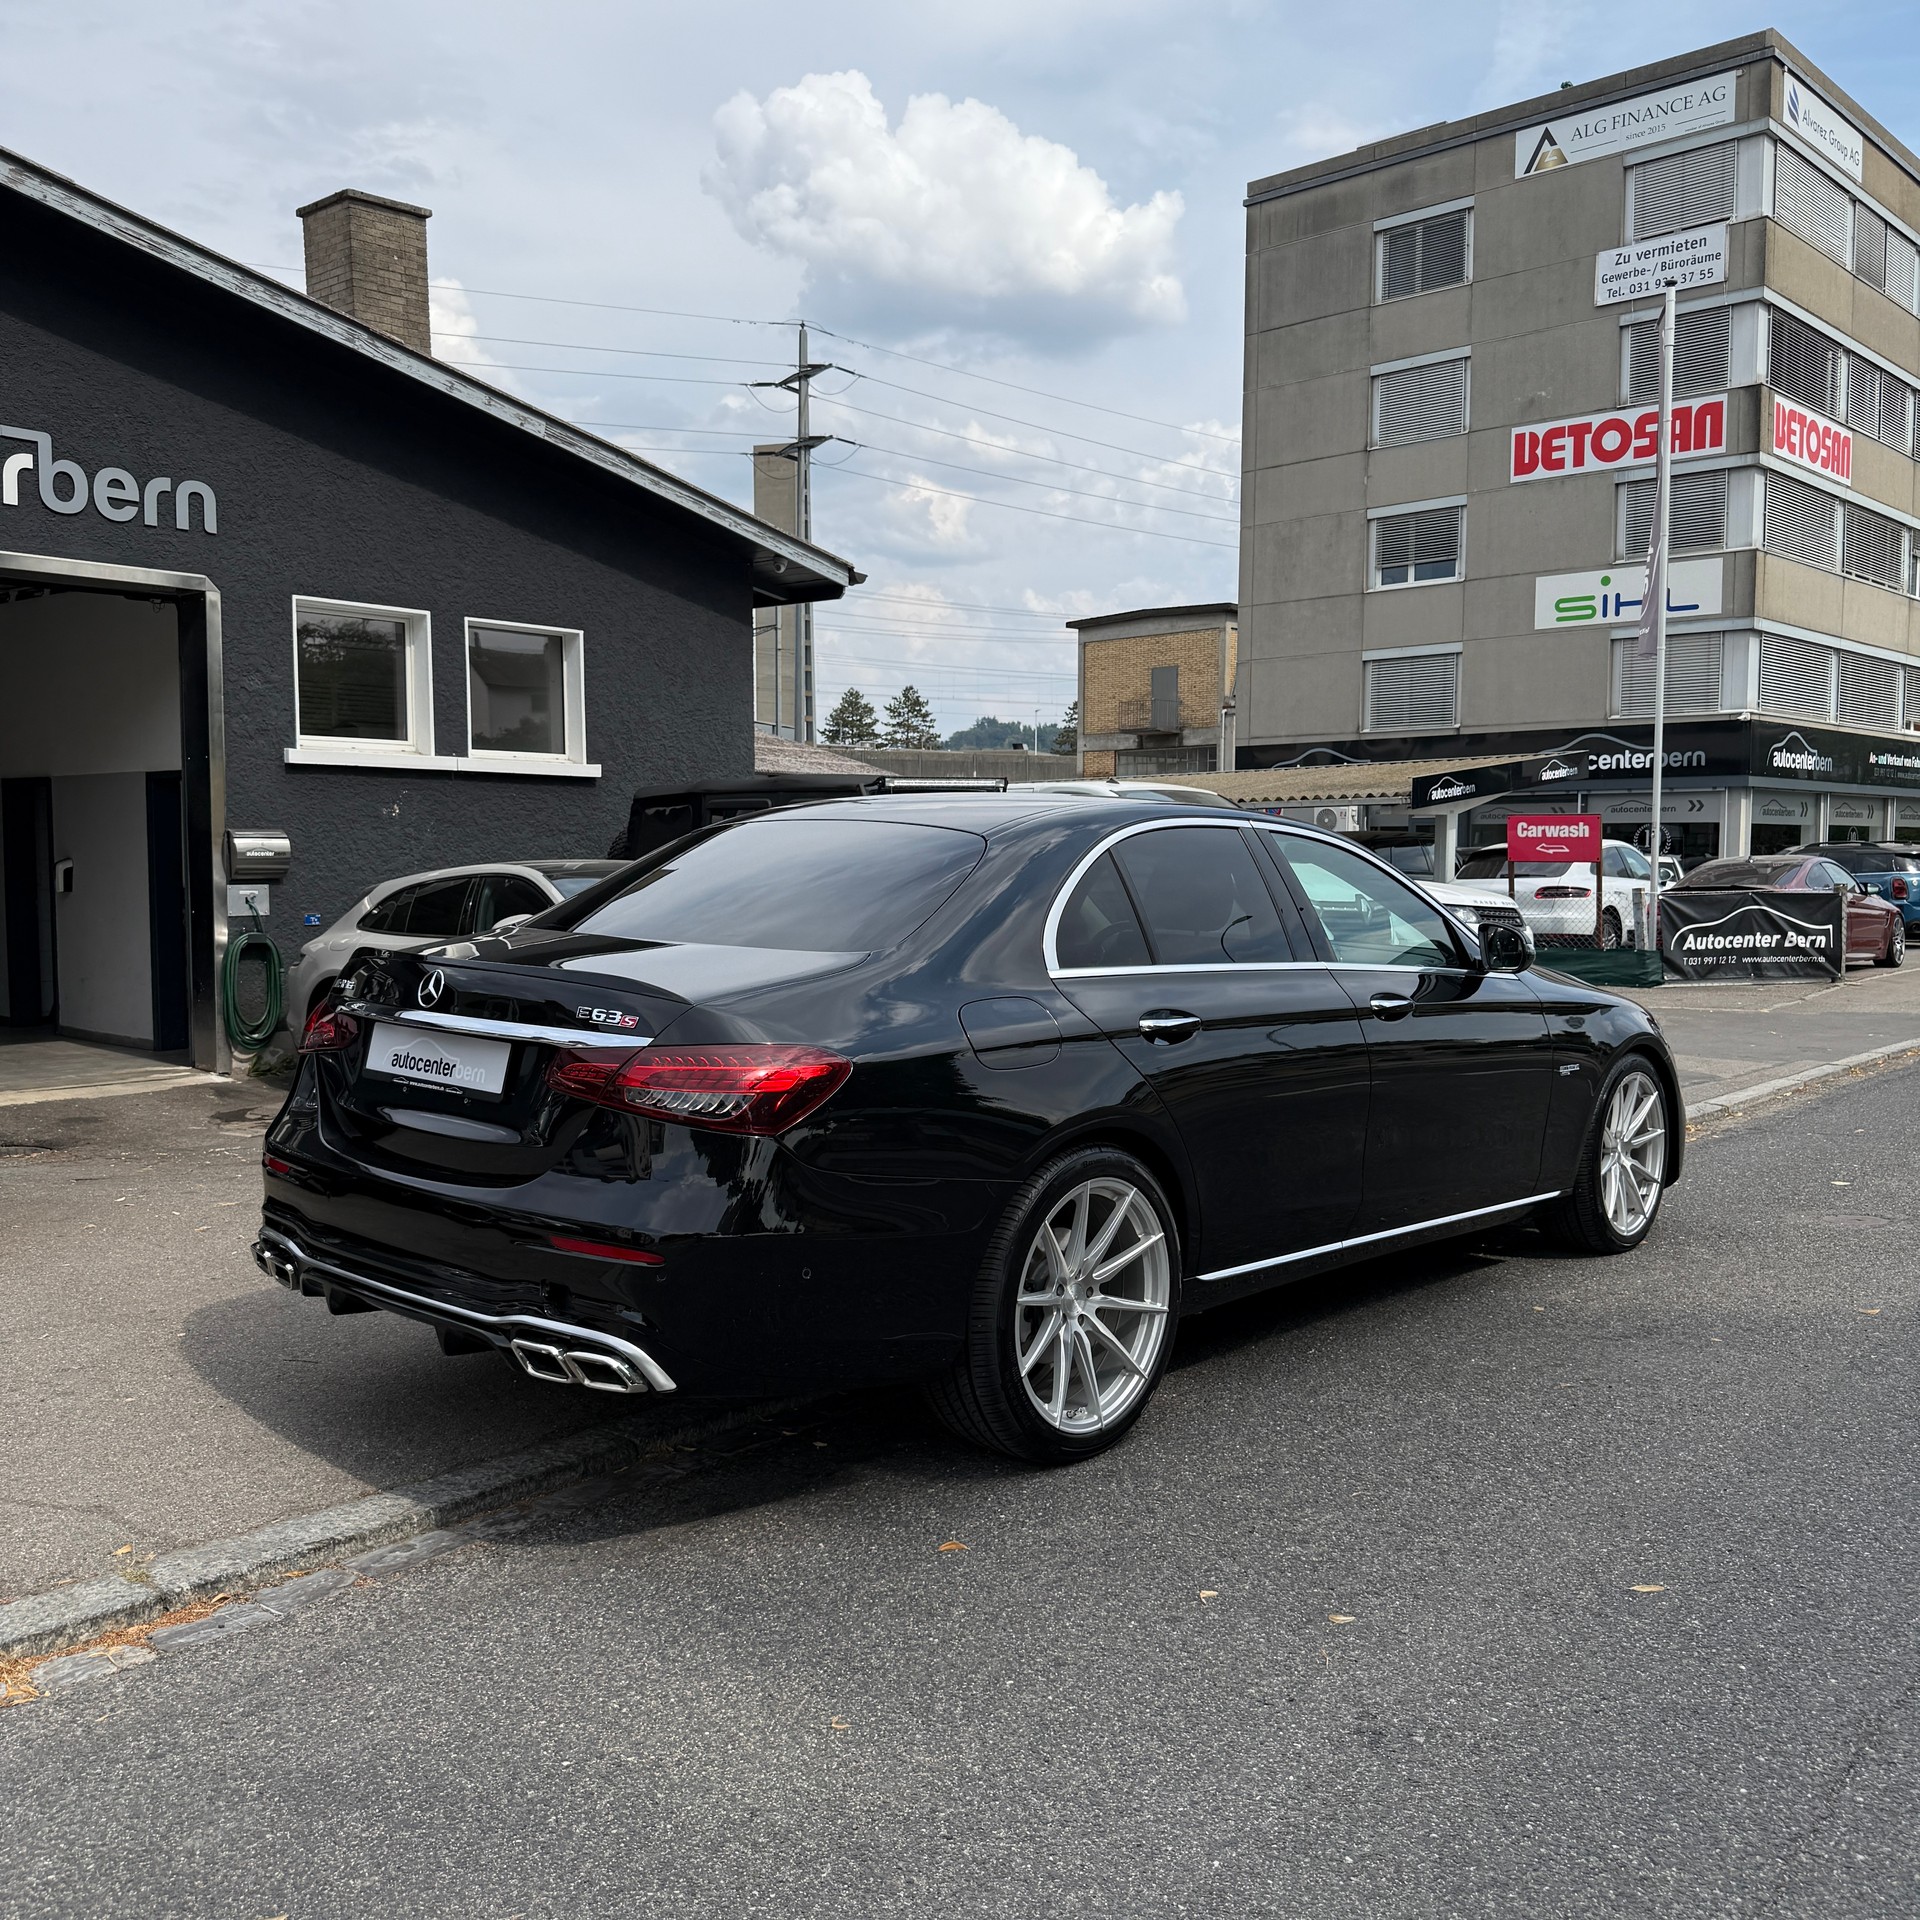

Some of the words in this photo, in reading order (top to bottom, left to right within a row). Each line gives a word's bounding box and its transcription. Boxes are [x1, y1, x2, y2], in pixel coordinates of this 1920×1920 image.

[1571, 119, 1607, 142] ALG
[1611, 95, 1694, 130] FINANCE
[1698, 86, 1727, 107] AG
[1626, 130, 1646, 141] since
[1648, 123, 1666, 136] 2015
[1802, 109, 1828, 141] Alvarez
[1828, 129, 1849, 161] Group
[1849, 147, 1860, 167] AG
[1614, 253, 1631, 266] Zu
[1636, 237, 1707, 261] vermieten
[1607, 286, 1625, 299] Tel.
[1629, 281, 1650, 294] 031
[1680, 271, 1695, 284] 37
[1699, 267, 1714, 280] 55
[1513, 400, 1724, 477] BETOSAN
[1775, 402, 1852, 480] BETOSAN
[1773, 748, 1833, 772] autocenterbern
[1431, 784, 1476, 800] autocenterbern
[1517, 822, 1590, 838] Carwash
[1683, 931, 1781, 950] Autocenter
[1784, 931, 1826, 948] Bern
[1703, 956, 1716, 965] 991
[1718, 956, 1726, 964] 12
[1728, 955, 1737, 964] 12
[1742, 954, 1826, 963] www.autocenterbern.ch
[391, 1052, 485, 1084] autocenterbern
